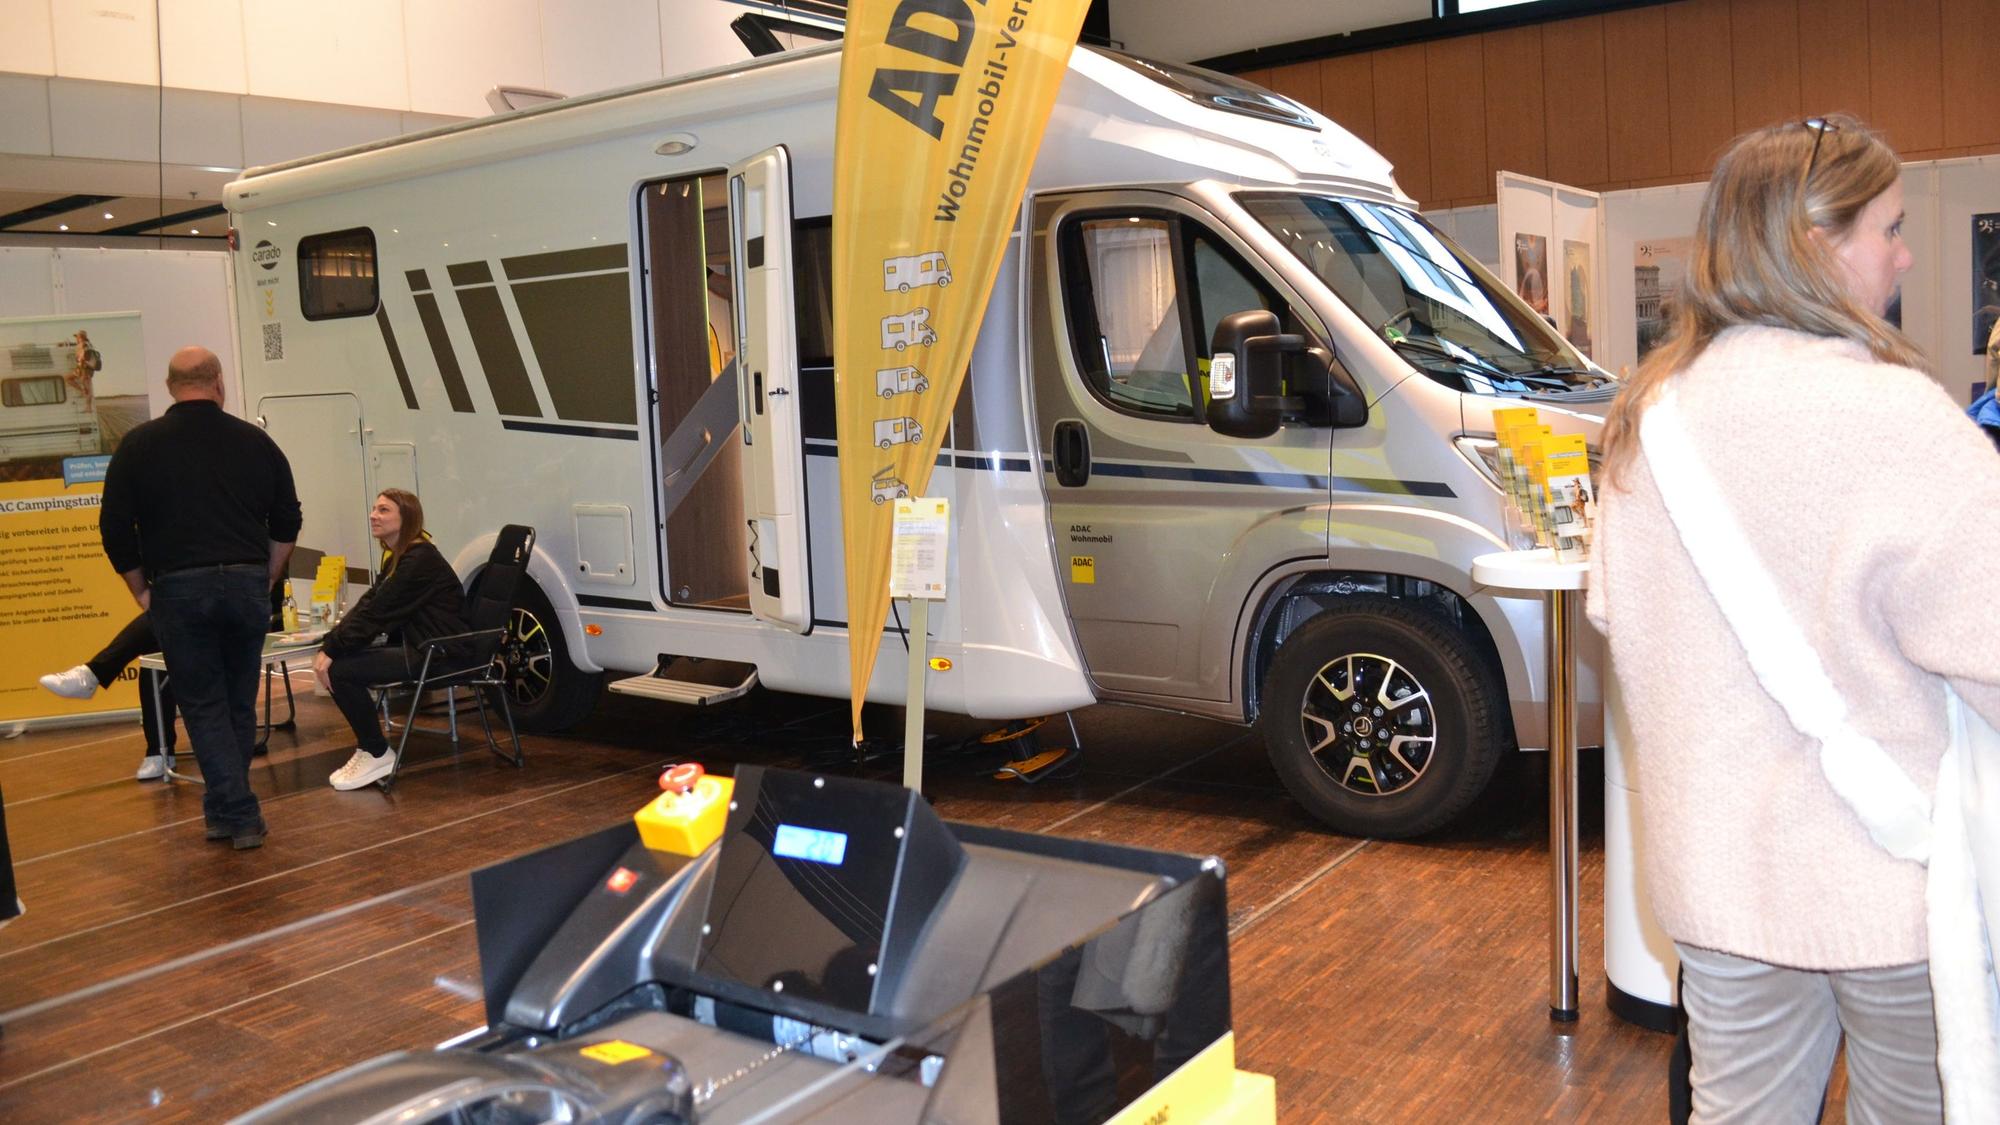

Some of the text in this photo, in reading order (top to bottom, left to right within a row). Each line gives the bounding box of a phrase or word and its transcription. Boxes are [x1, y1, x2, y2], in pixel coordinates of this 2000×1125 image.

[868, 0, 988, 141] AD
[934, 0, 1033, 222] Wohnmobil-Ver
[252, 246, 281, 262] carado
[17, 495, 103, 511] Campingstati
[12, 526, 59, 537] vorbereitet
[1071, 535, 1112, 543] Wohnmobil
[1072, 558, 1092, 567] ADAC
